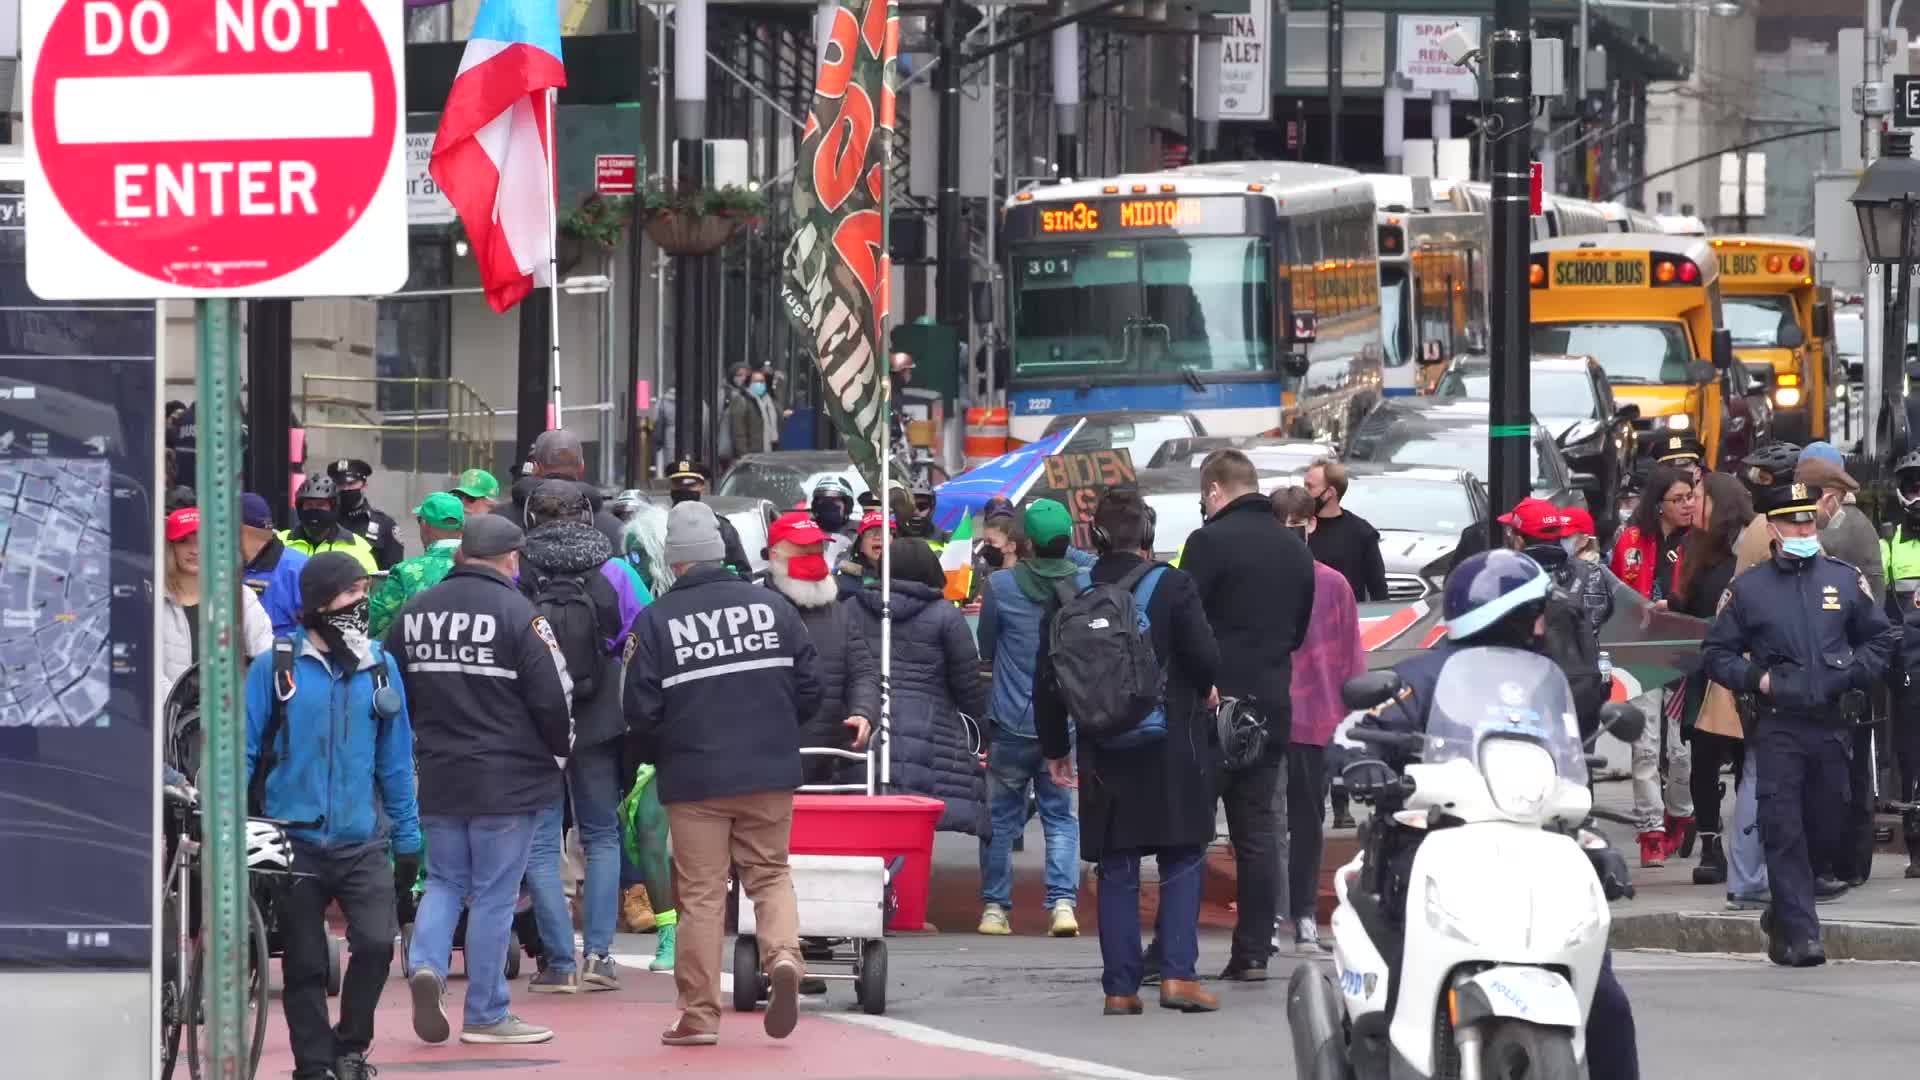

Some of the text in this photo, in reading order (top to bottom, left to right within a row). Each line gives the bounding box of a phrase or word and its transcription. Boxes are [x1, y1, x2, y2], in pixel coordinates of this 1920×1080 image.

[84, 0, 338, 56] DO NOT
[114, 160, 318, 218] ENTER
[1556, 260, 1643, 285] SCHOOL BUS
[1733, 254, 1757, 273] BUS
[1043, 448, 1137, 489] BIDEN
[403, 611, 496, 643] NYPD
[668, 603, 775, 647] NYPD
[404, 643, 495, 664] POLICE
[675, 632, 780, 666] POLICE
